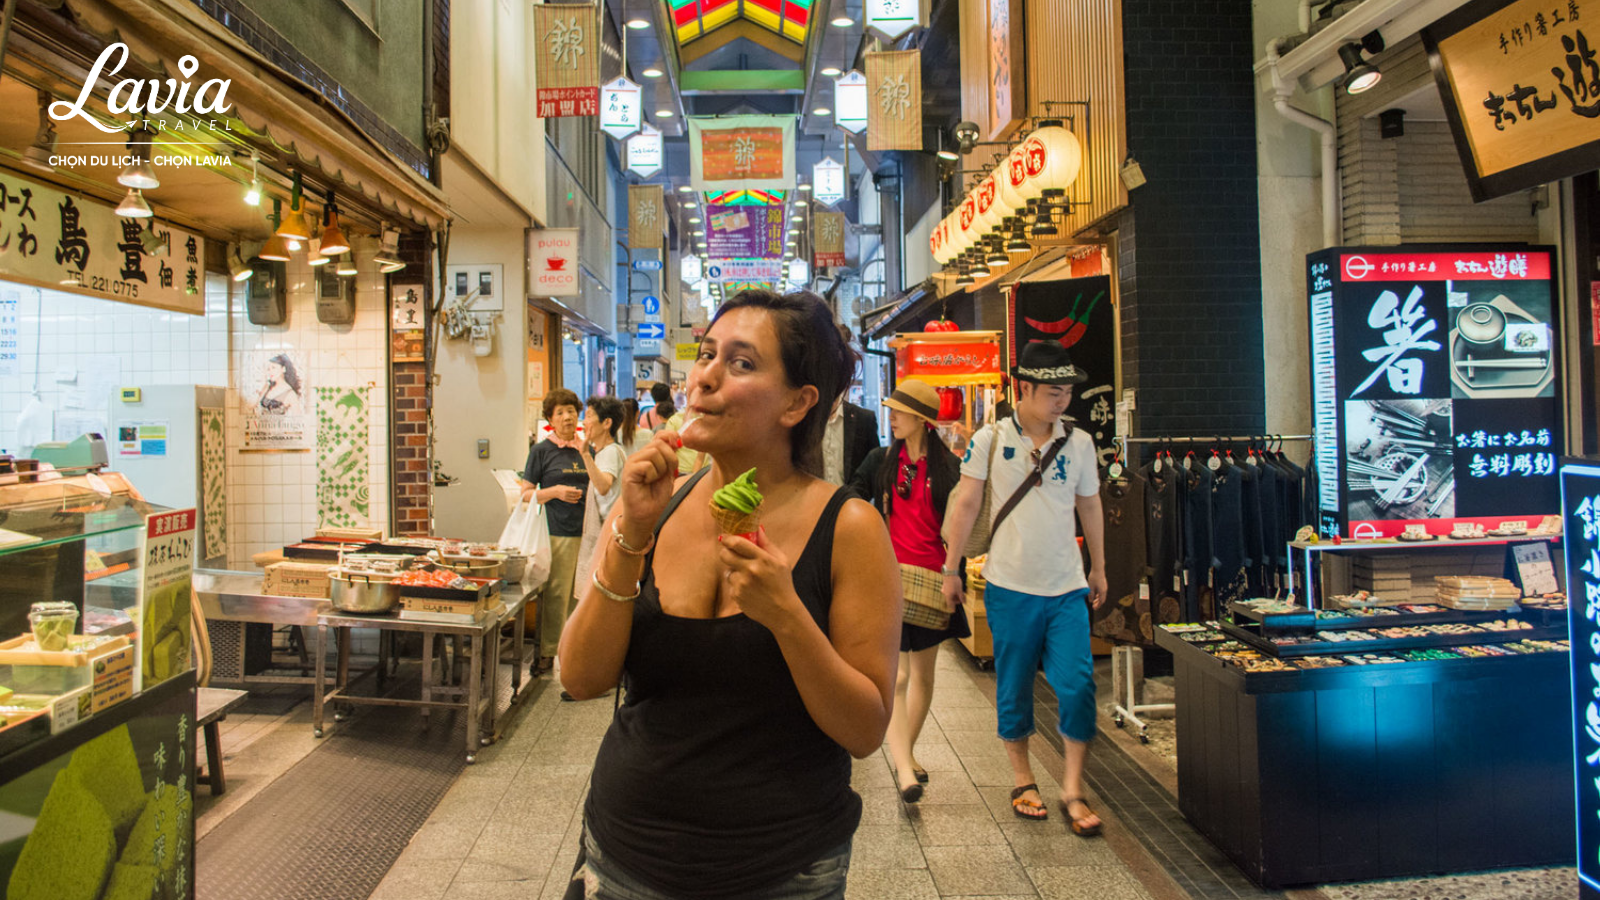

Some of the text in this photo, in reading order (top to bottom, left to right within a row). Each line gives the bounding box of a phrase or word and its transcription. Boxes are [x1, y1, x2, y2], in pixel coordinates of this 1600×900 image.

[540, 99, 596, 117] 加盟店
[538, 239, 571, 249] pulau
[1381, 261, 1437, 273] 手作り箸工房
[539, 274, 573, 283] deco
[1349, 284, 1442, 399] 箸
[1455, 428, 1551, 448] お箸にお名前
[1468, 452, 1556, 477] 無料彫刻
